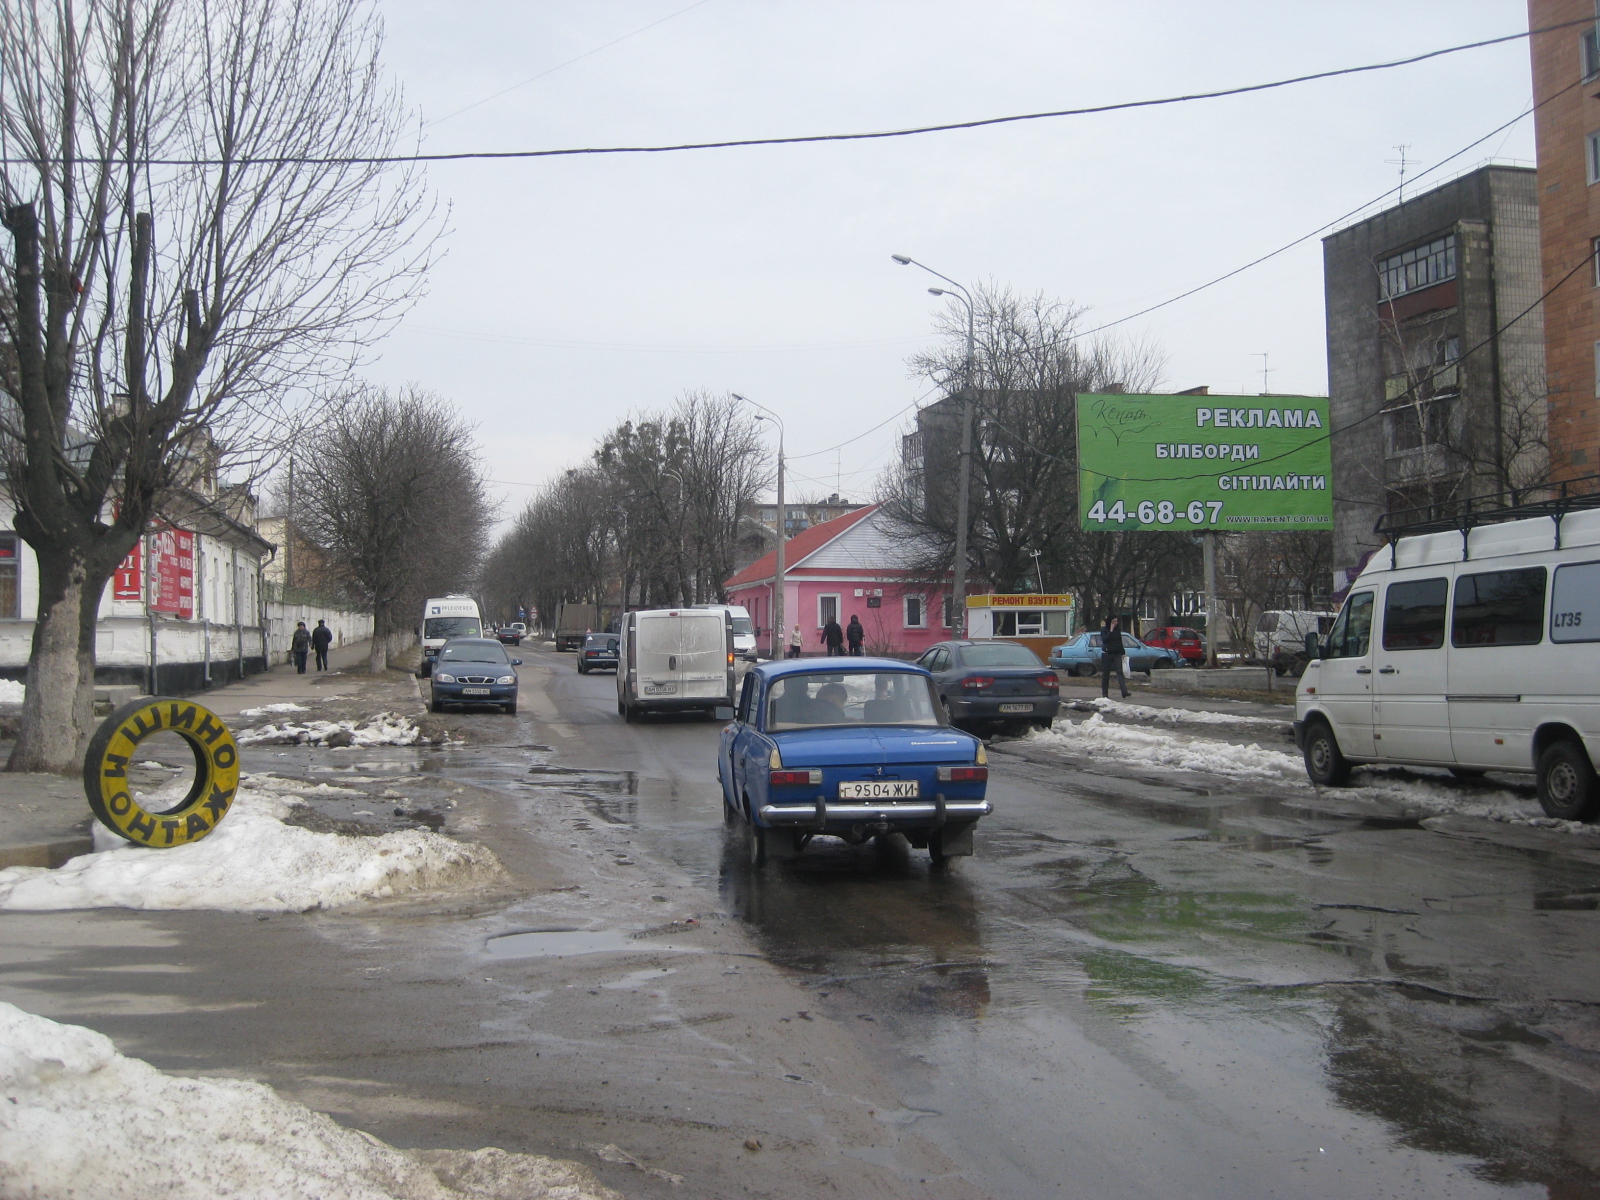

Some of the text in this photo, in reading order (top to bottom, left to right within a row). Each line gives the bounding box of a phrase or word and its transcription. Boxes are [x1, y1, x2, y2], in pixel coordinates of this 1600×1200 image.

[1196, 407, 1322, 428] РЕКЛАМА
[1155, 443, 1259, 461] БІЛБОРДИ
[1218, 472, 1326, 490] СІТІЛАЙТИ
[1087, 499, 1224, 524] 44-68-67
[1226, 515, 1330, 523] WWW.RAKENT.COM.UA
[992, 596, 1058, 605] РЕМОНТ ВЗУТТЯ
[1554, 611, 1582, 627] LT35
[855, 784, 889, 797] 9504
[893, 784, 914, 797] ЖИ
